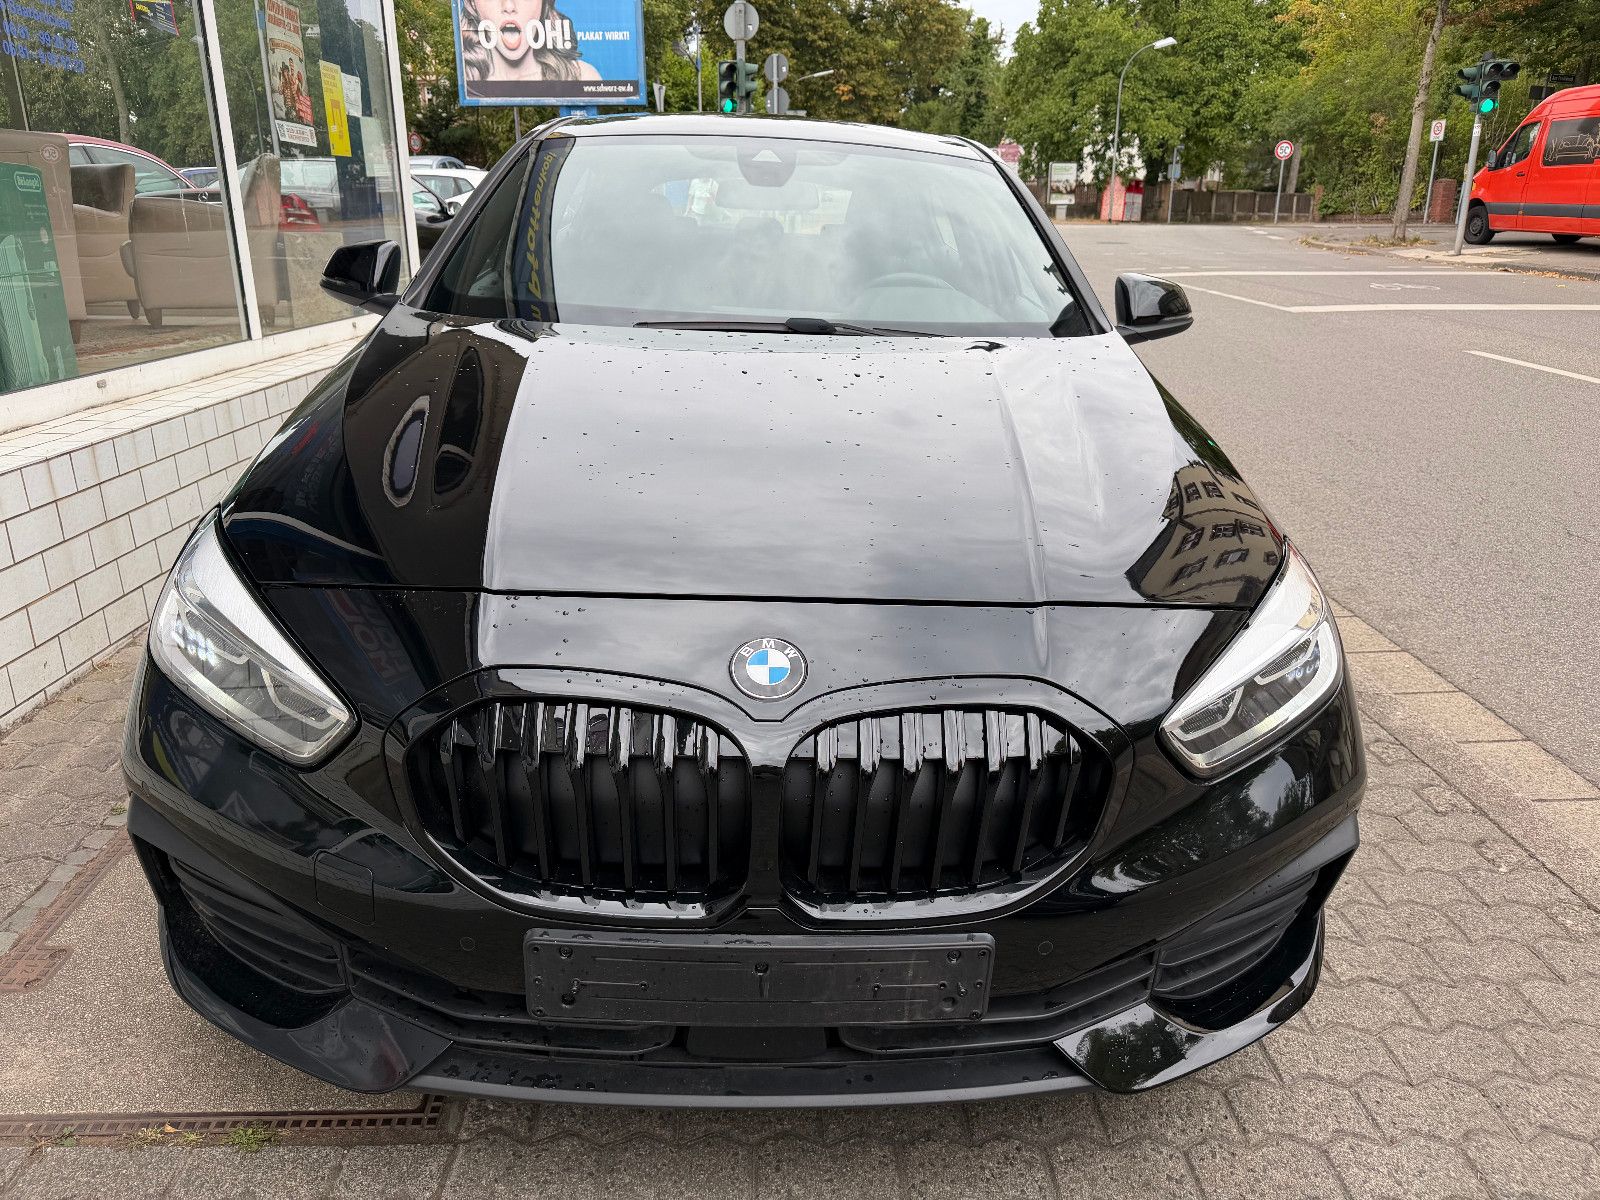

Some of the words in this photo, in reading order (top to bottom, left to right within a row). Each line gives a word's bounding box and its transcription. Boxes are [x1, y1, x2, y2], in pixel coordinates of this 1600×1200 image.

[577, 31, 602, 41] PLAKAT
[605, 31, 630, 41] WIRKT!
[740, 640, 798, 659] BMW
